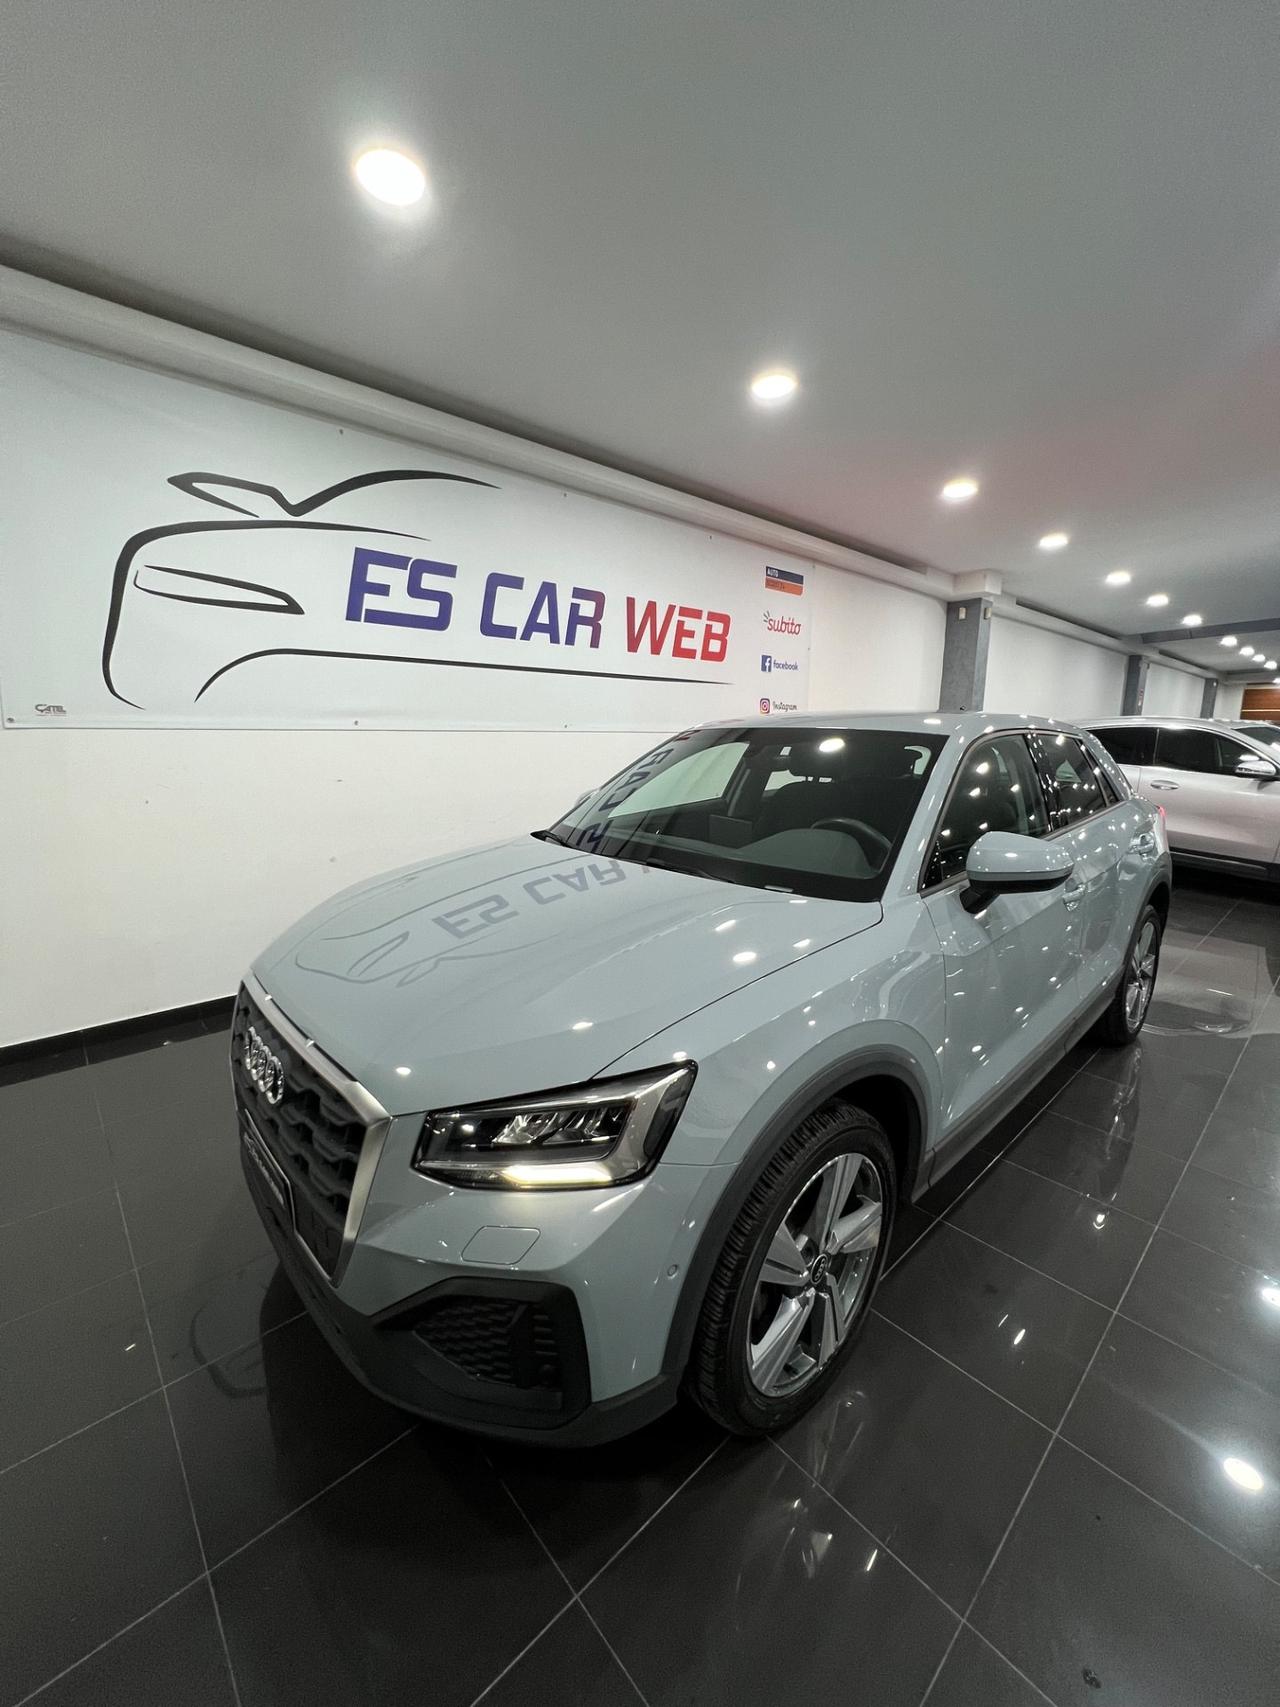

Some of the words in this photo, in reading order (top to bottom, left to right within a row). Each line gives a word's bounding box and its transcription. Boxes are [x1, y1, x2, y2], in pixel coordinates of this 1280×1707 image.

[345, 547, 457, 631] ES
[479, 572, 606, 648] CAR
[626, 596, 731, 663] WEB
[767, 616, 801, 635] subito
[773, 659, 799, 671] facebook
